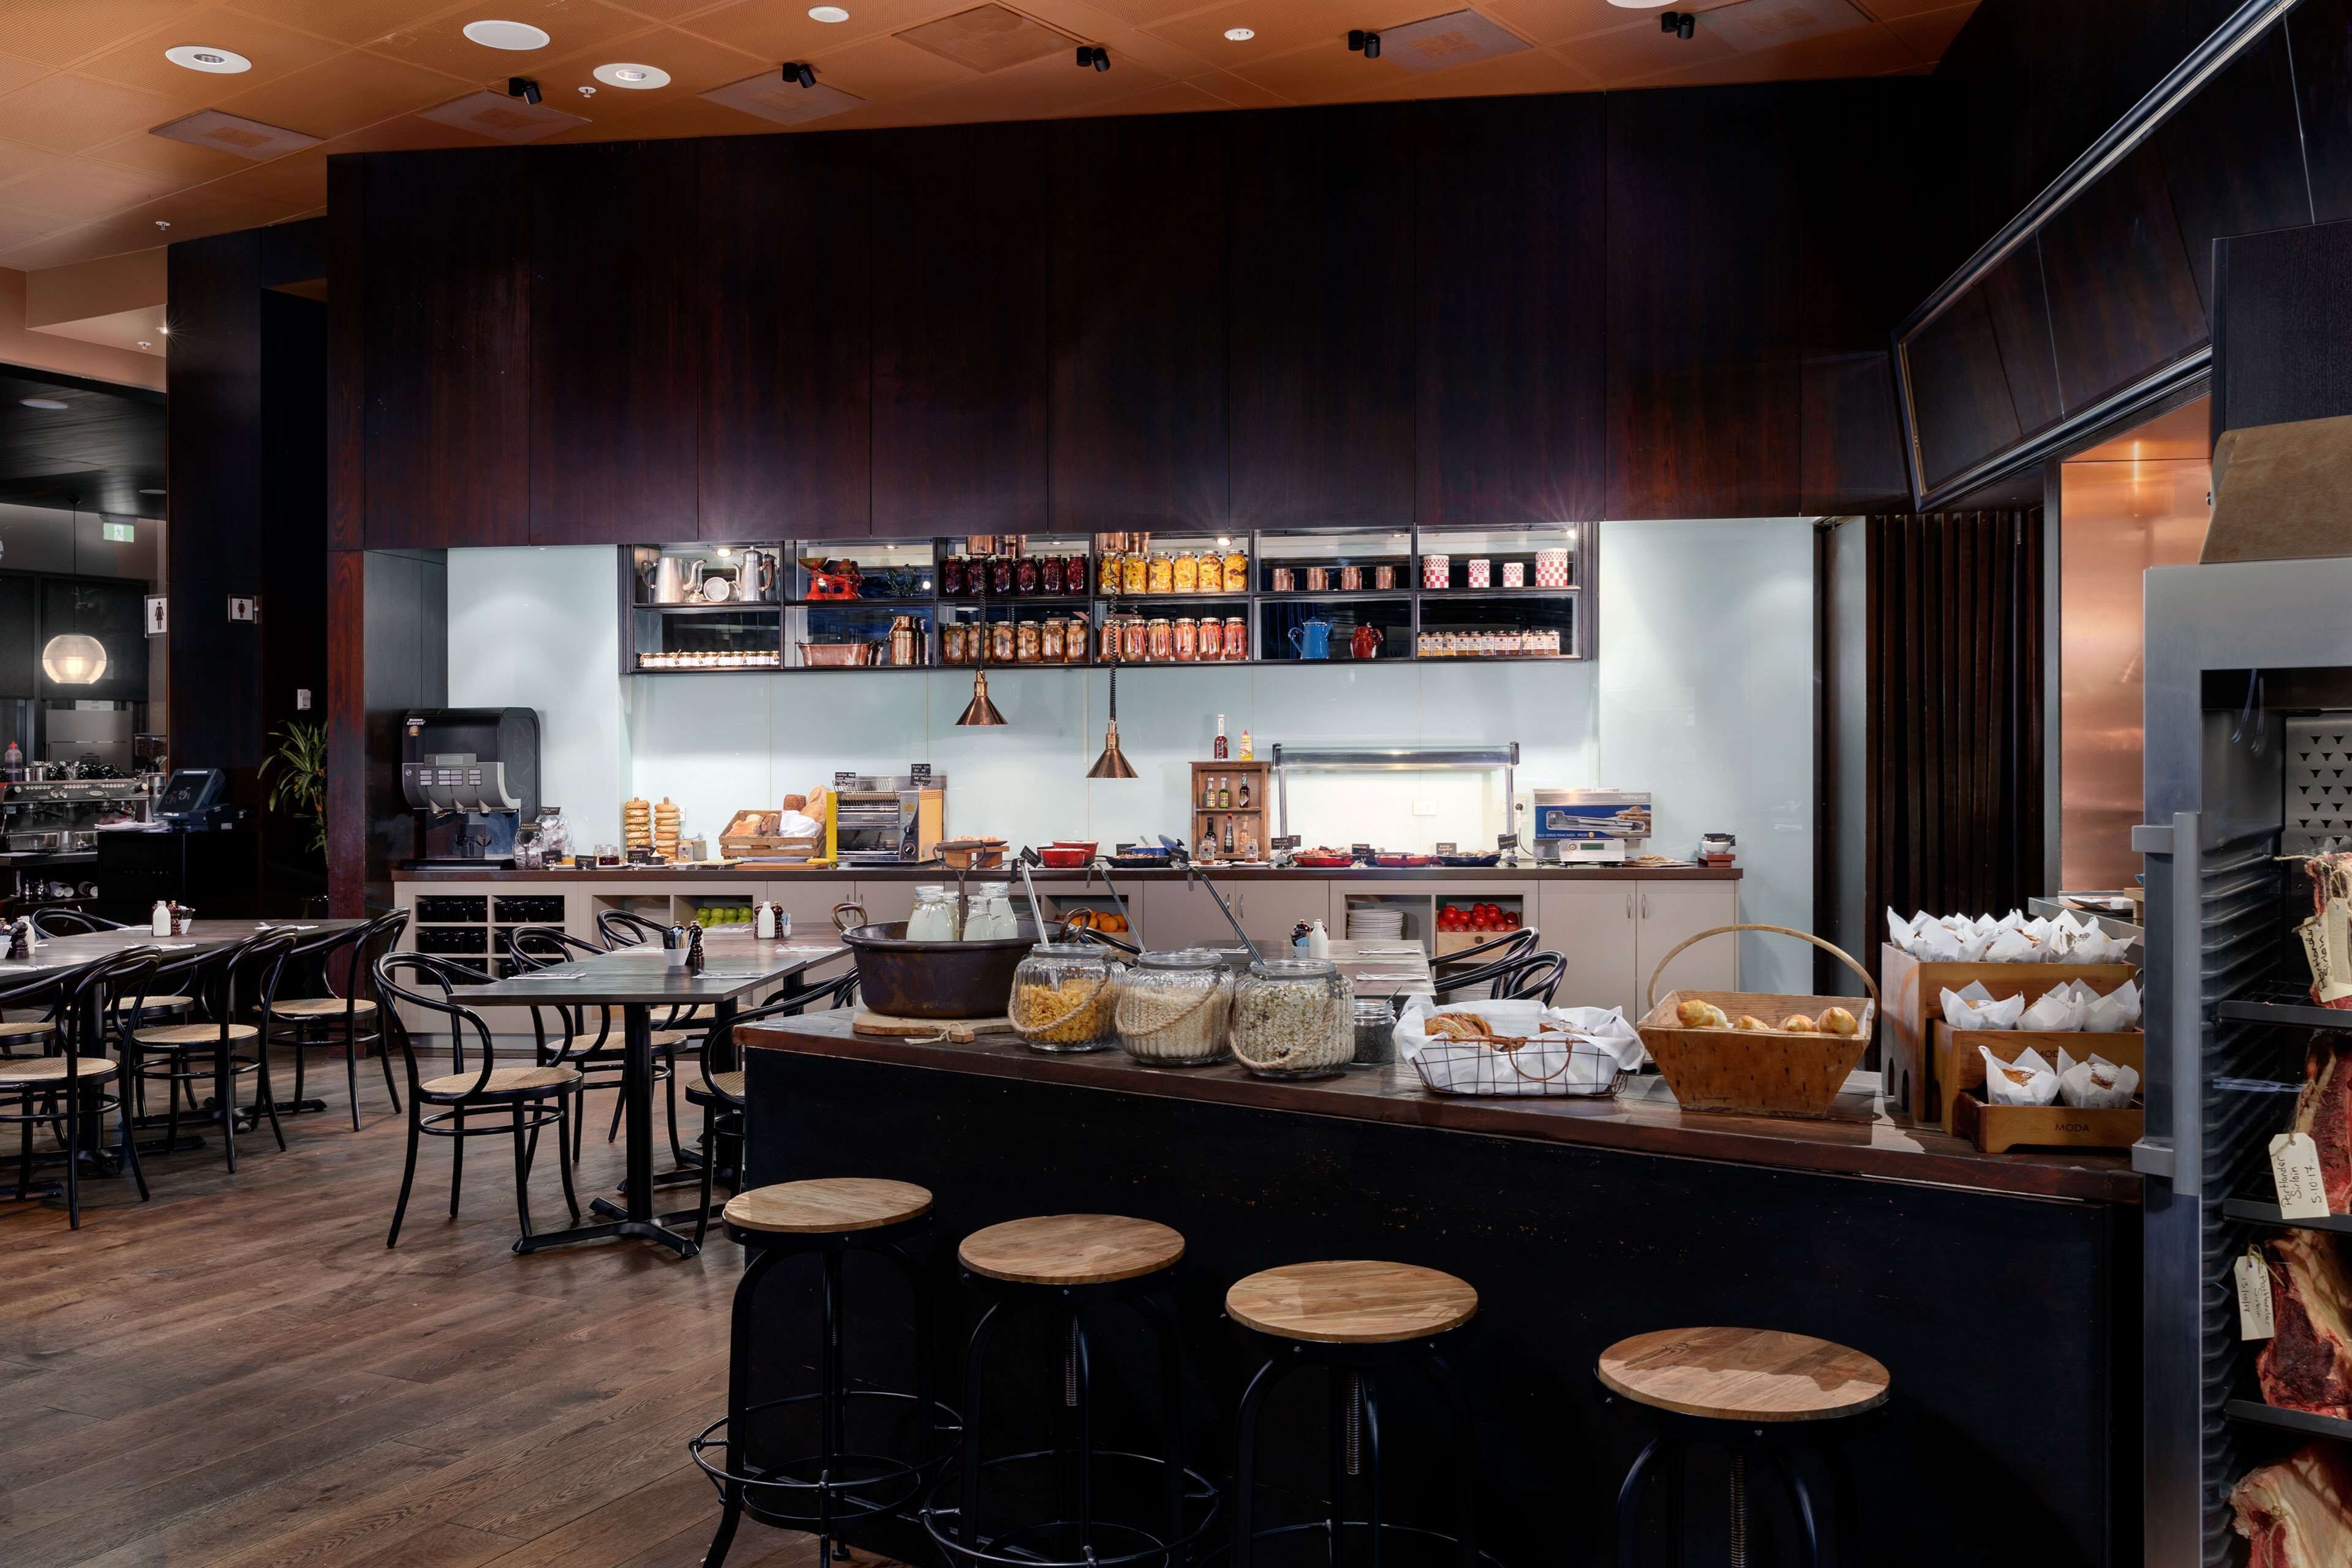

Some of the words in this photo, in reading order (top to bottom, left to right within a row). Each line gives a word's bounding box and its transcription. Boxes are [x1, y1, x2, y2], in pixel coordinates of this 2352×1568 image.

[2306, 925, 2328, 992] Portlander
[2319, 935, 2332, 976] Sirloin
[2055, 1123, 2090, 1133] MODA
[2277, 1155, 2293, 1207] Portlander
[2290, 1166, 2302, 1199] Sirloin
[2260, 1272, 2271, 1327] Portlander
